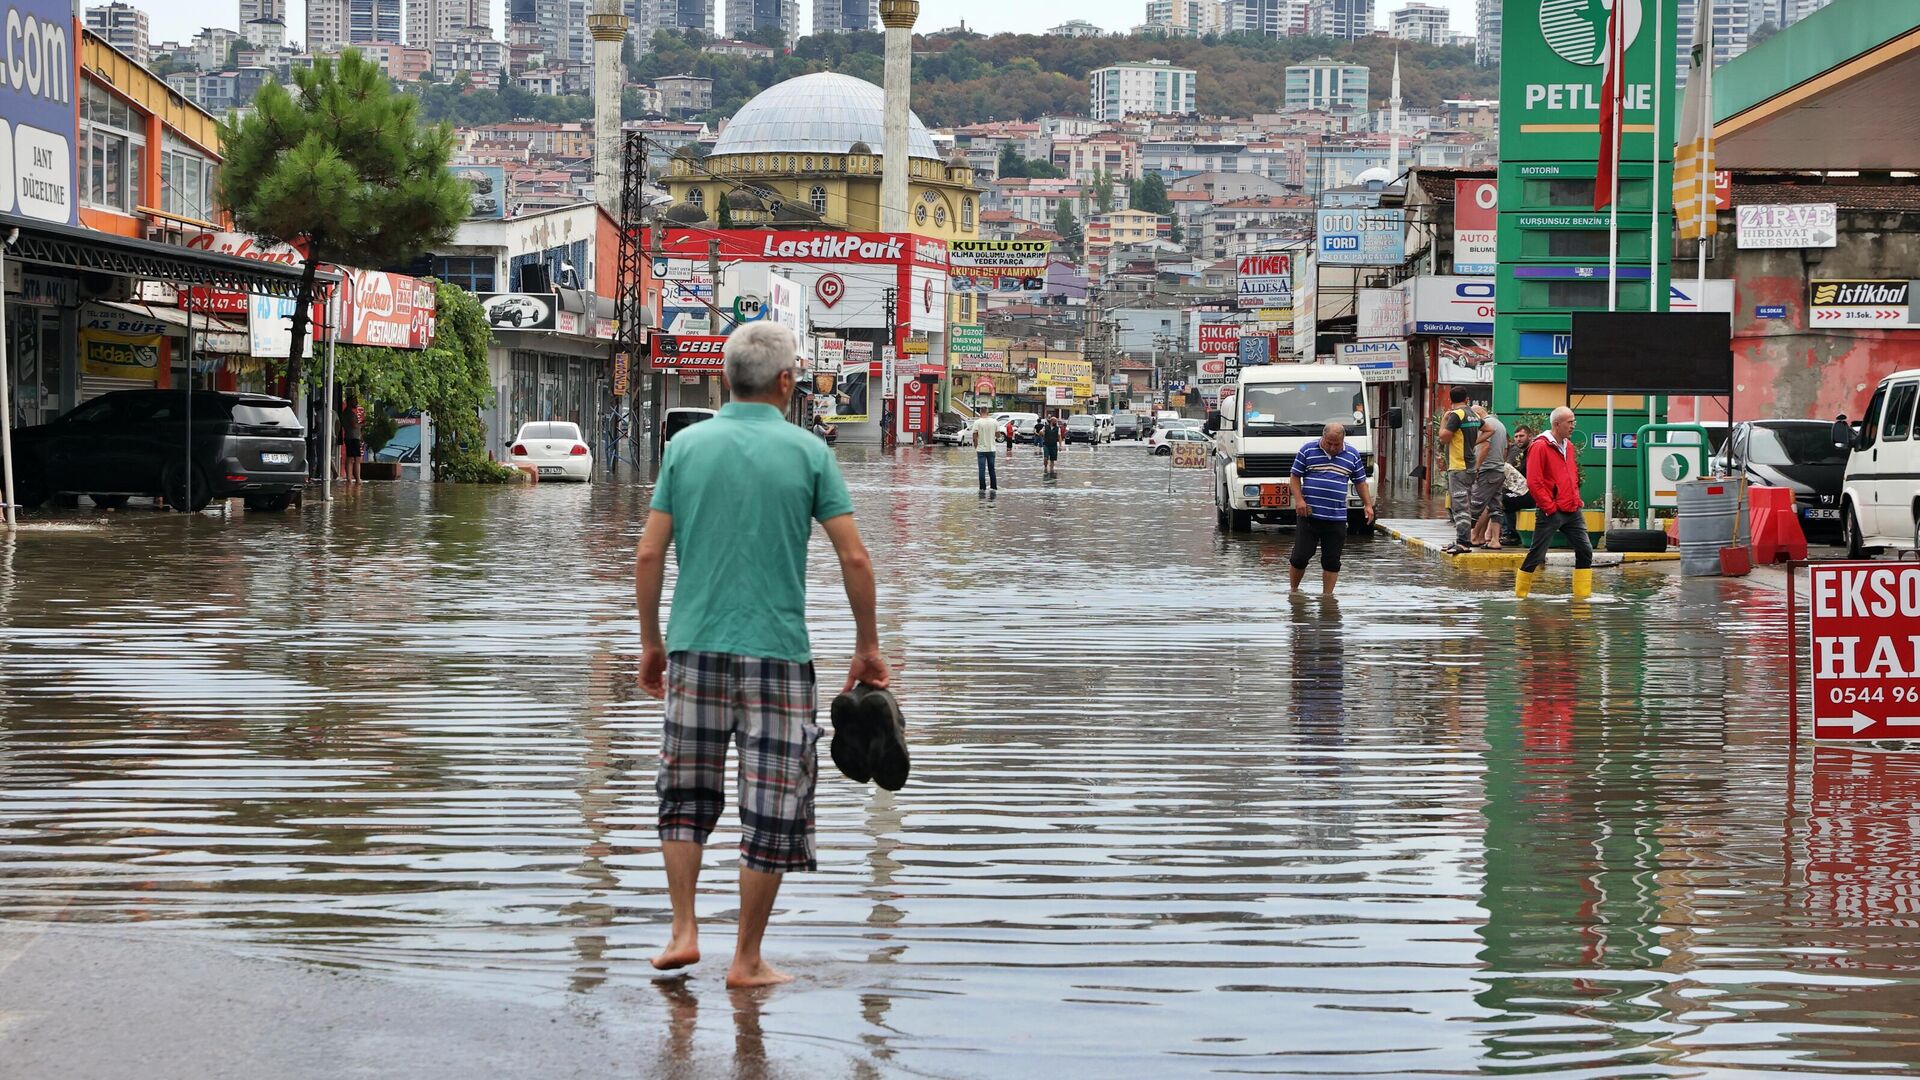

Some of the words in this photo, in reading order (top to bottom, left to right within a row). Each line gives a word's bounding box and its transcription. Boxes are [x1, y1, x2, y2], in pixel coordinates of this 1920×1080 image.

[1526, 84, 1651, 110] PETLNE
[33, 146, 53, 170] JANT
[1521, 166, 1560, 174] MOTORİN
[22, 173, 65, 206] DÜZELTME
[1323, 215, 1353, 232] OTO
[1520, 218, 1570, 226] KURŞUNSUZ
[1573, 217, 1602, 225] BENZİN
[1460, 233, 1490, 242] AUTO
[1743, 229, 1809, 237] HIRDAVAT
[953, 241, 1008, 251] KUTLU
[1012, 242, 1045, 251] OTO
[1326, 237, 1356, 249] FORD
[1742, 237, 1810, 246] AKSESUAR
[763, 235, 905, 259] LastikPark
[983, 267, 1000, 276] DEV
[1837, 284, 1907, 303] istikbal
[217, 298, 229, 309] 47
[740, 302, 759, 312] LPG
[88, 320, 111, 329] AS
[117, 321, 167, 334] BÜFE
[1424, 323, 1443, 332] Şükrü
[1444, 324, 1465, 332] Arsoy
[367, 320, 410, 346] RESTAURANT
[679, 341, 726, 353] CEBE
[952, 344, 981, 352] ÖLÇÜMÜ
[680, 357, 728, 366] AKSESU
[1176, 446, 1205, 456] OTO
[1174, 457, 1205, 466] CAM
[1275, 486, 1288, 495] 33
[1261, 496, 1288, 505] 1203
[1809, 510, 1819, 518] 55
[1823, 510, 1834, 518] EK
[1815, 569, 1920, 618] EKSO
[1830, 687, 1884, 704] 0544
[1892, 686, 1919, 703] 96
